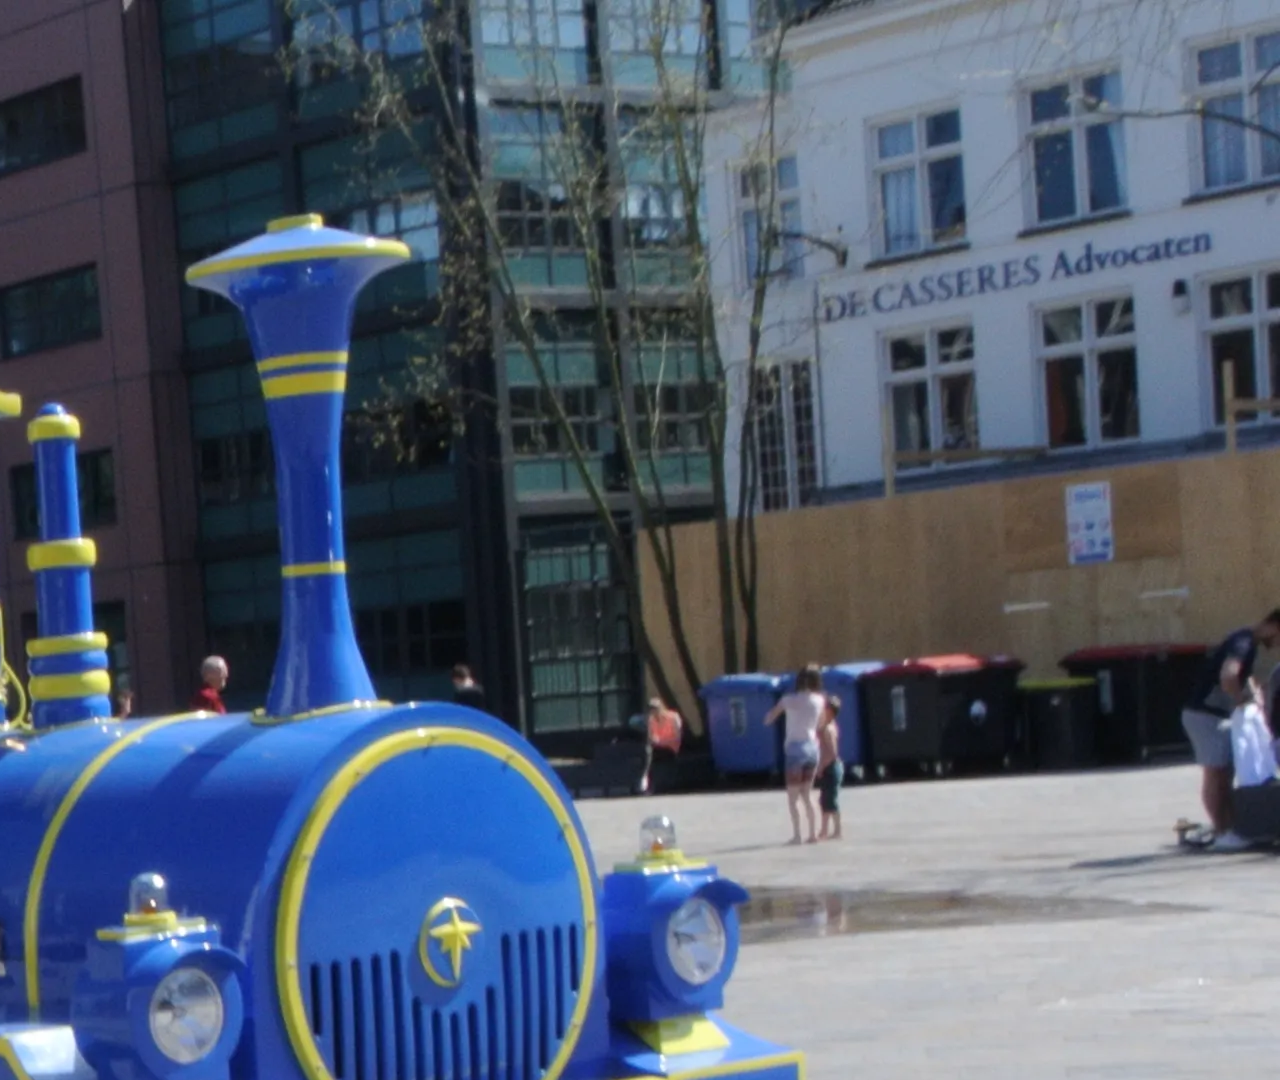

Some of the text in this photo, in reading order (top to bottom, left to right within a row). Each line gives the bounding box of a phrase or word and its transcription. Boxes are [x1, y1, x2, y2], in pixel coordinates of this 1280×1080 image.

[823, 231, 1213, 323] DE CASSERES Advocaten
